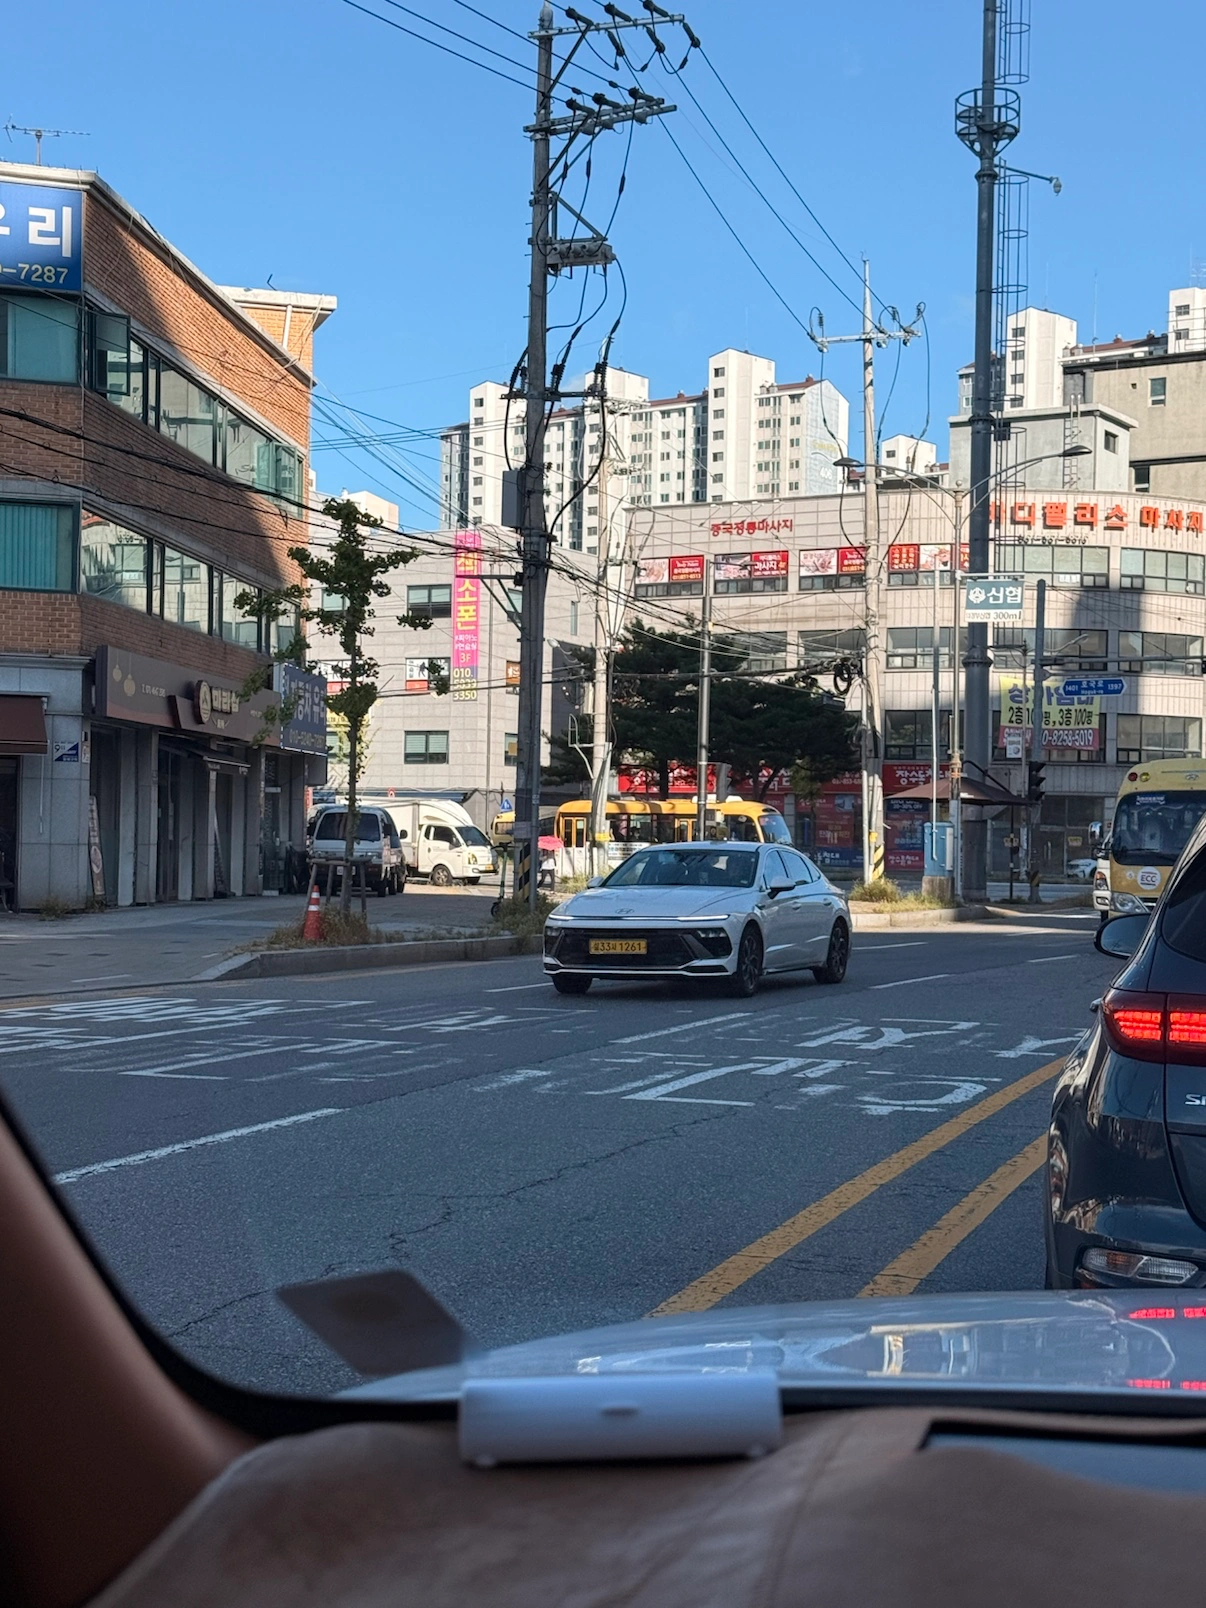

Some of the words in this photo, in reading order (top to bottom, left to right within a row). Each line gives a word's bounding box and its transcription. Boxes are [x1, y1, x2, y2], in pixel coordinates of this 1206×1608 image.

[0, 263, 68, 284] -7287
[1141, 505, 1204, 533] 마사지
[986, 586, 1022, 604] 신협
[993, 611, 1018, 620] 300m
[460, 652, 472, 663] 3F
[1081, 680, 1104, 689] 호국로
[1008, 707, 1023, 725] 2층
[1058, 708, 1072, 726] 3층
[1042, 729, 1094, 746] 0-8258-5019
[1140, 875, 1156, 883] ECC
[619, 942, 641, 952] 1261
